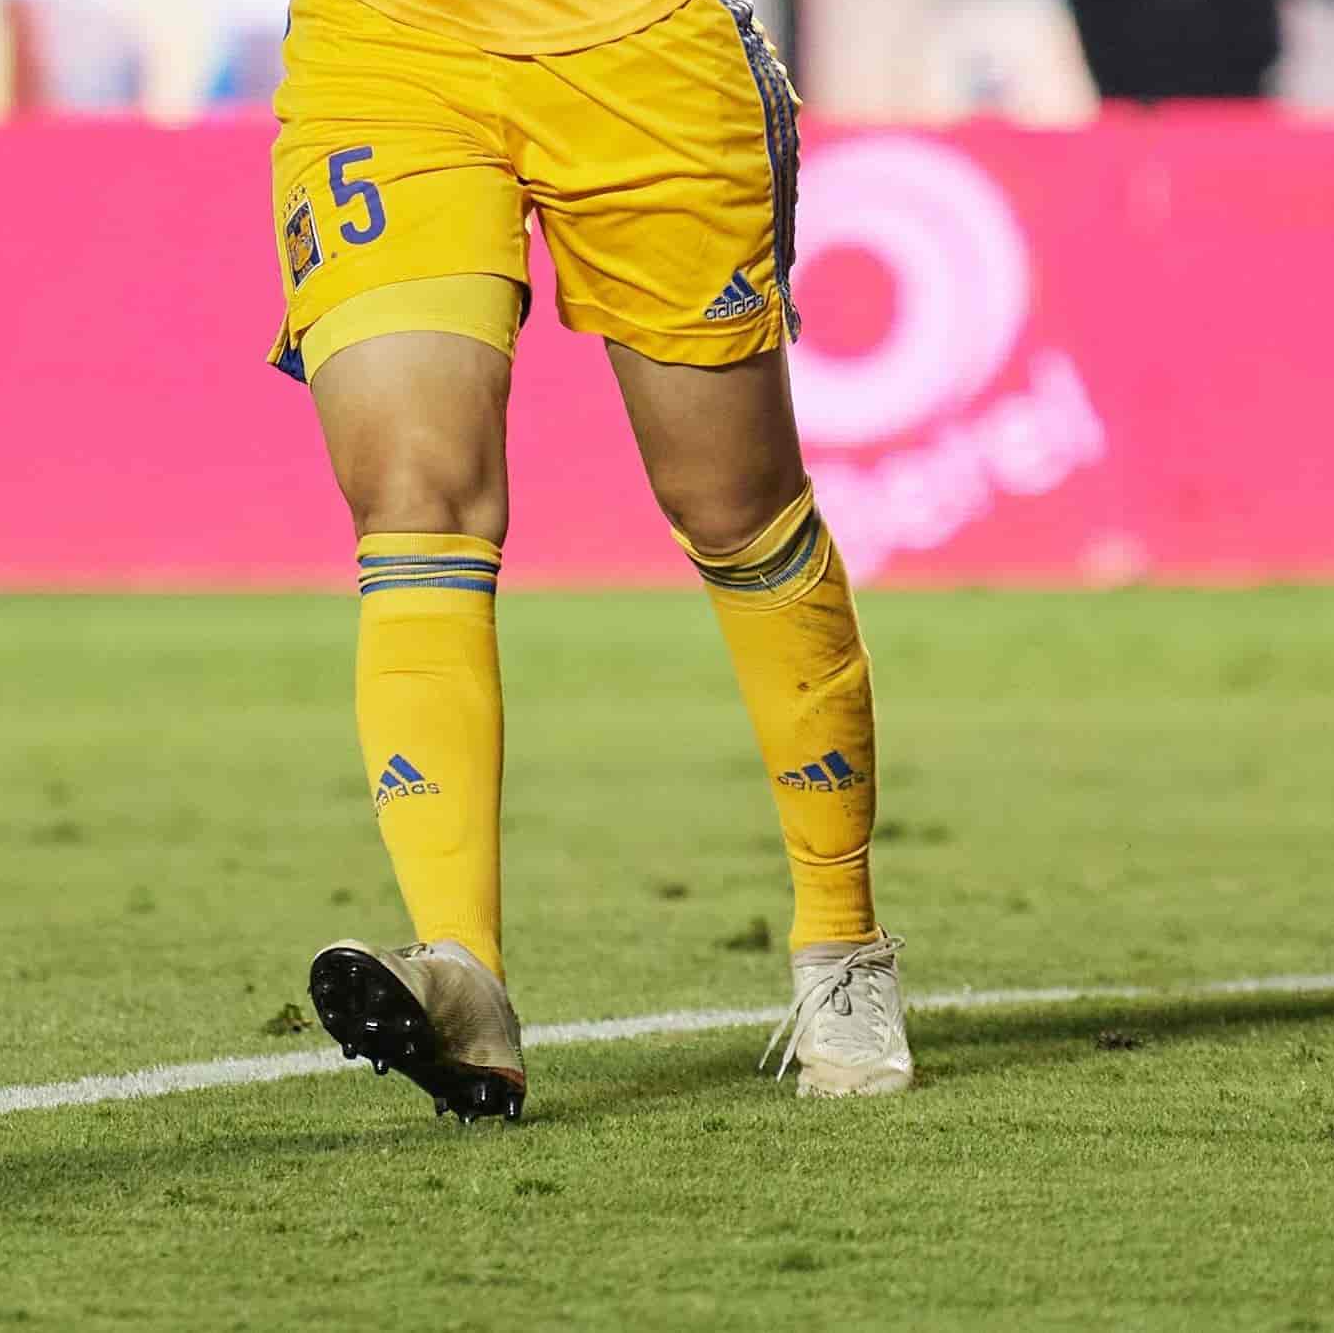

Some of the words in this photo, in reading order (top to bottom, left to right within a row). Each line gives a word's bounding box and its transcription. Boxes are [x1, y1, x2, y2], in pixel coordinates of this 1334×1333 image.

[327, 145, 387, 246] 5
[704, 294, 765, 319] adidas
[777, 770, 867, 793] adidas
